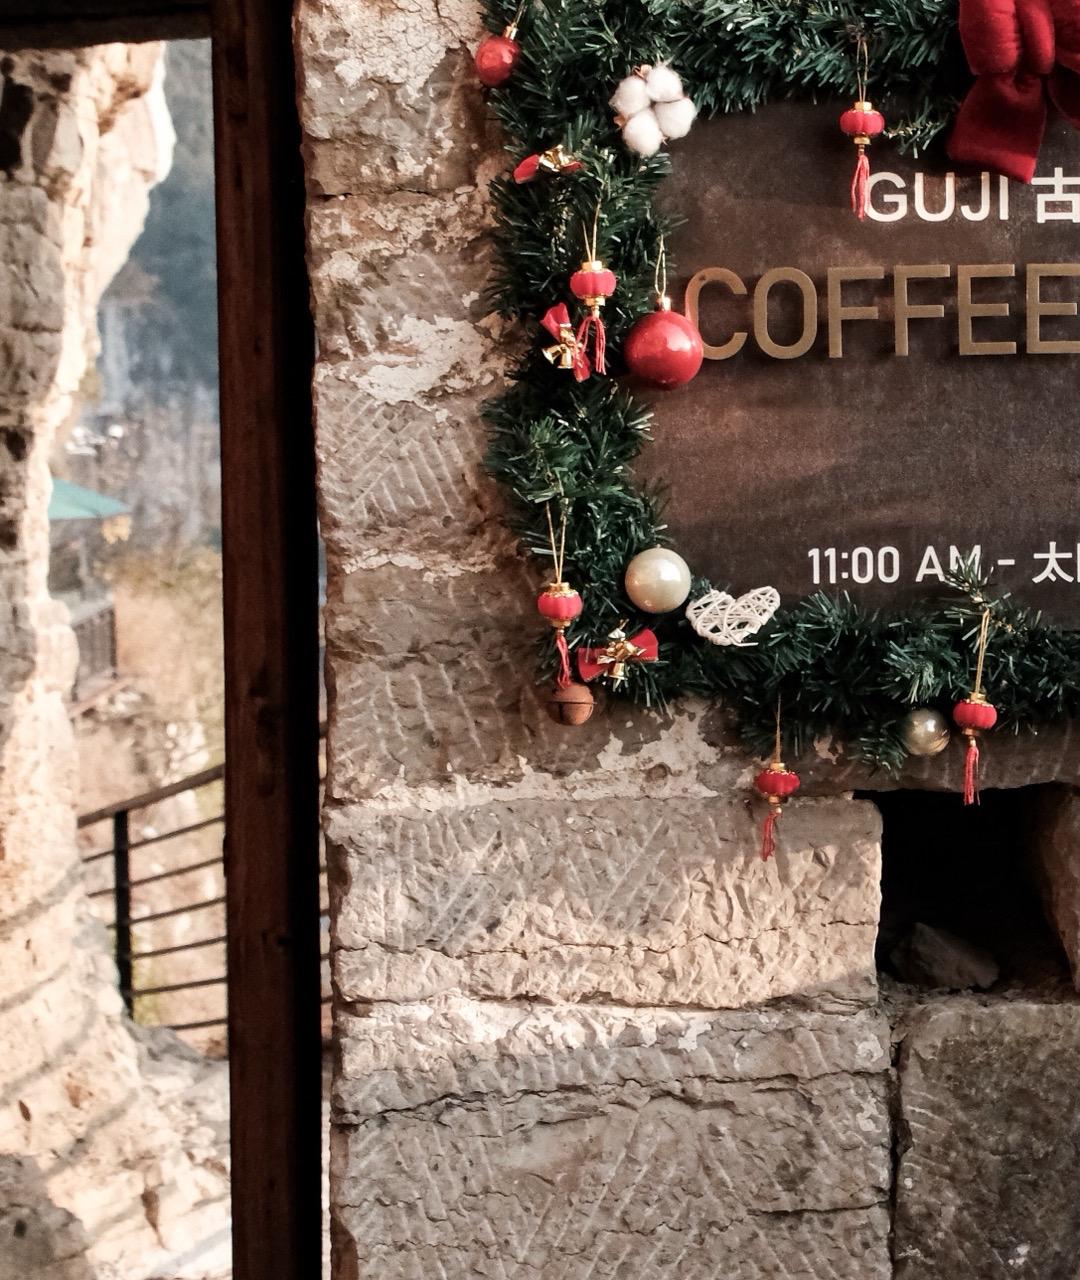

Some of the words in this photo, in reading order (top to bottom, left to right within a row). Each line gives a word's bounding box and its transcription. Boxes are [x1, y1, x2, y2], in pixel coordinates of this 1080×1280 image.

[864, 171, 1009, 222] GUJI
[807, 546, 900, 584] 11:00
[915, 544, 982, 582] AM
